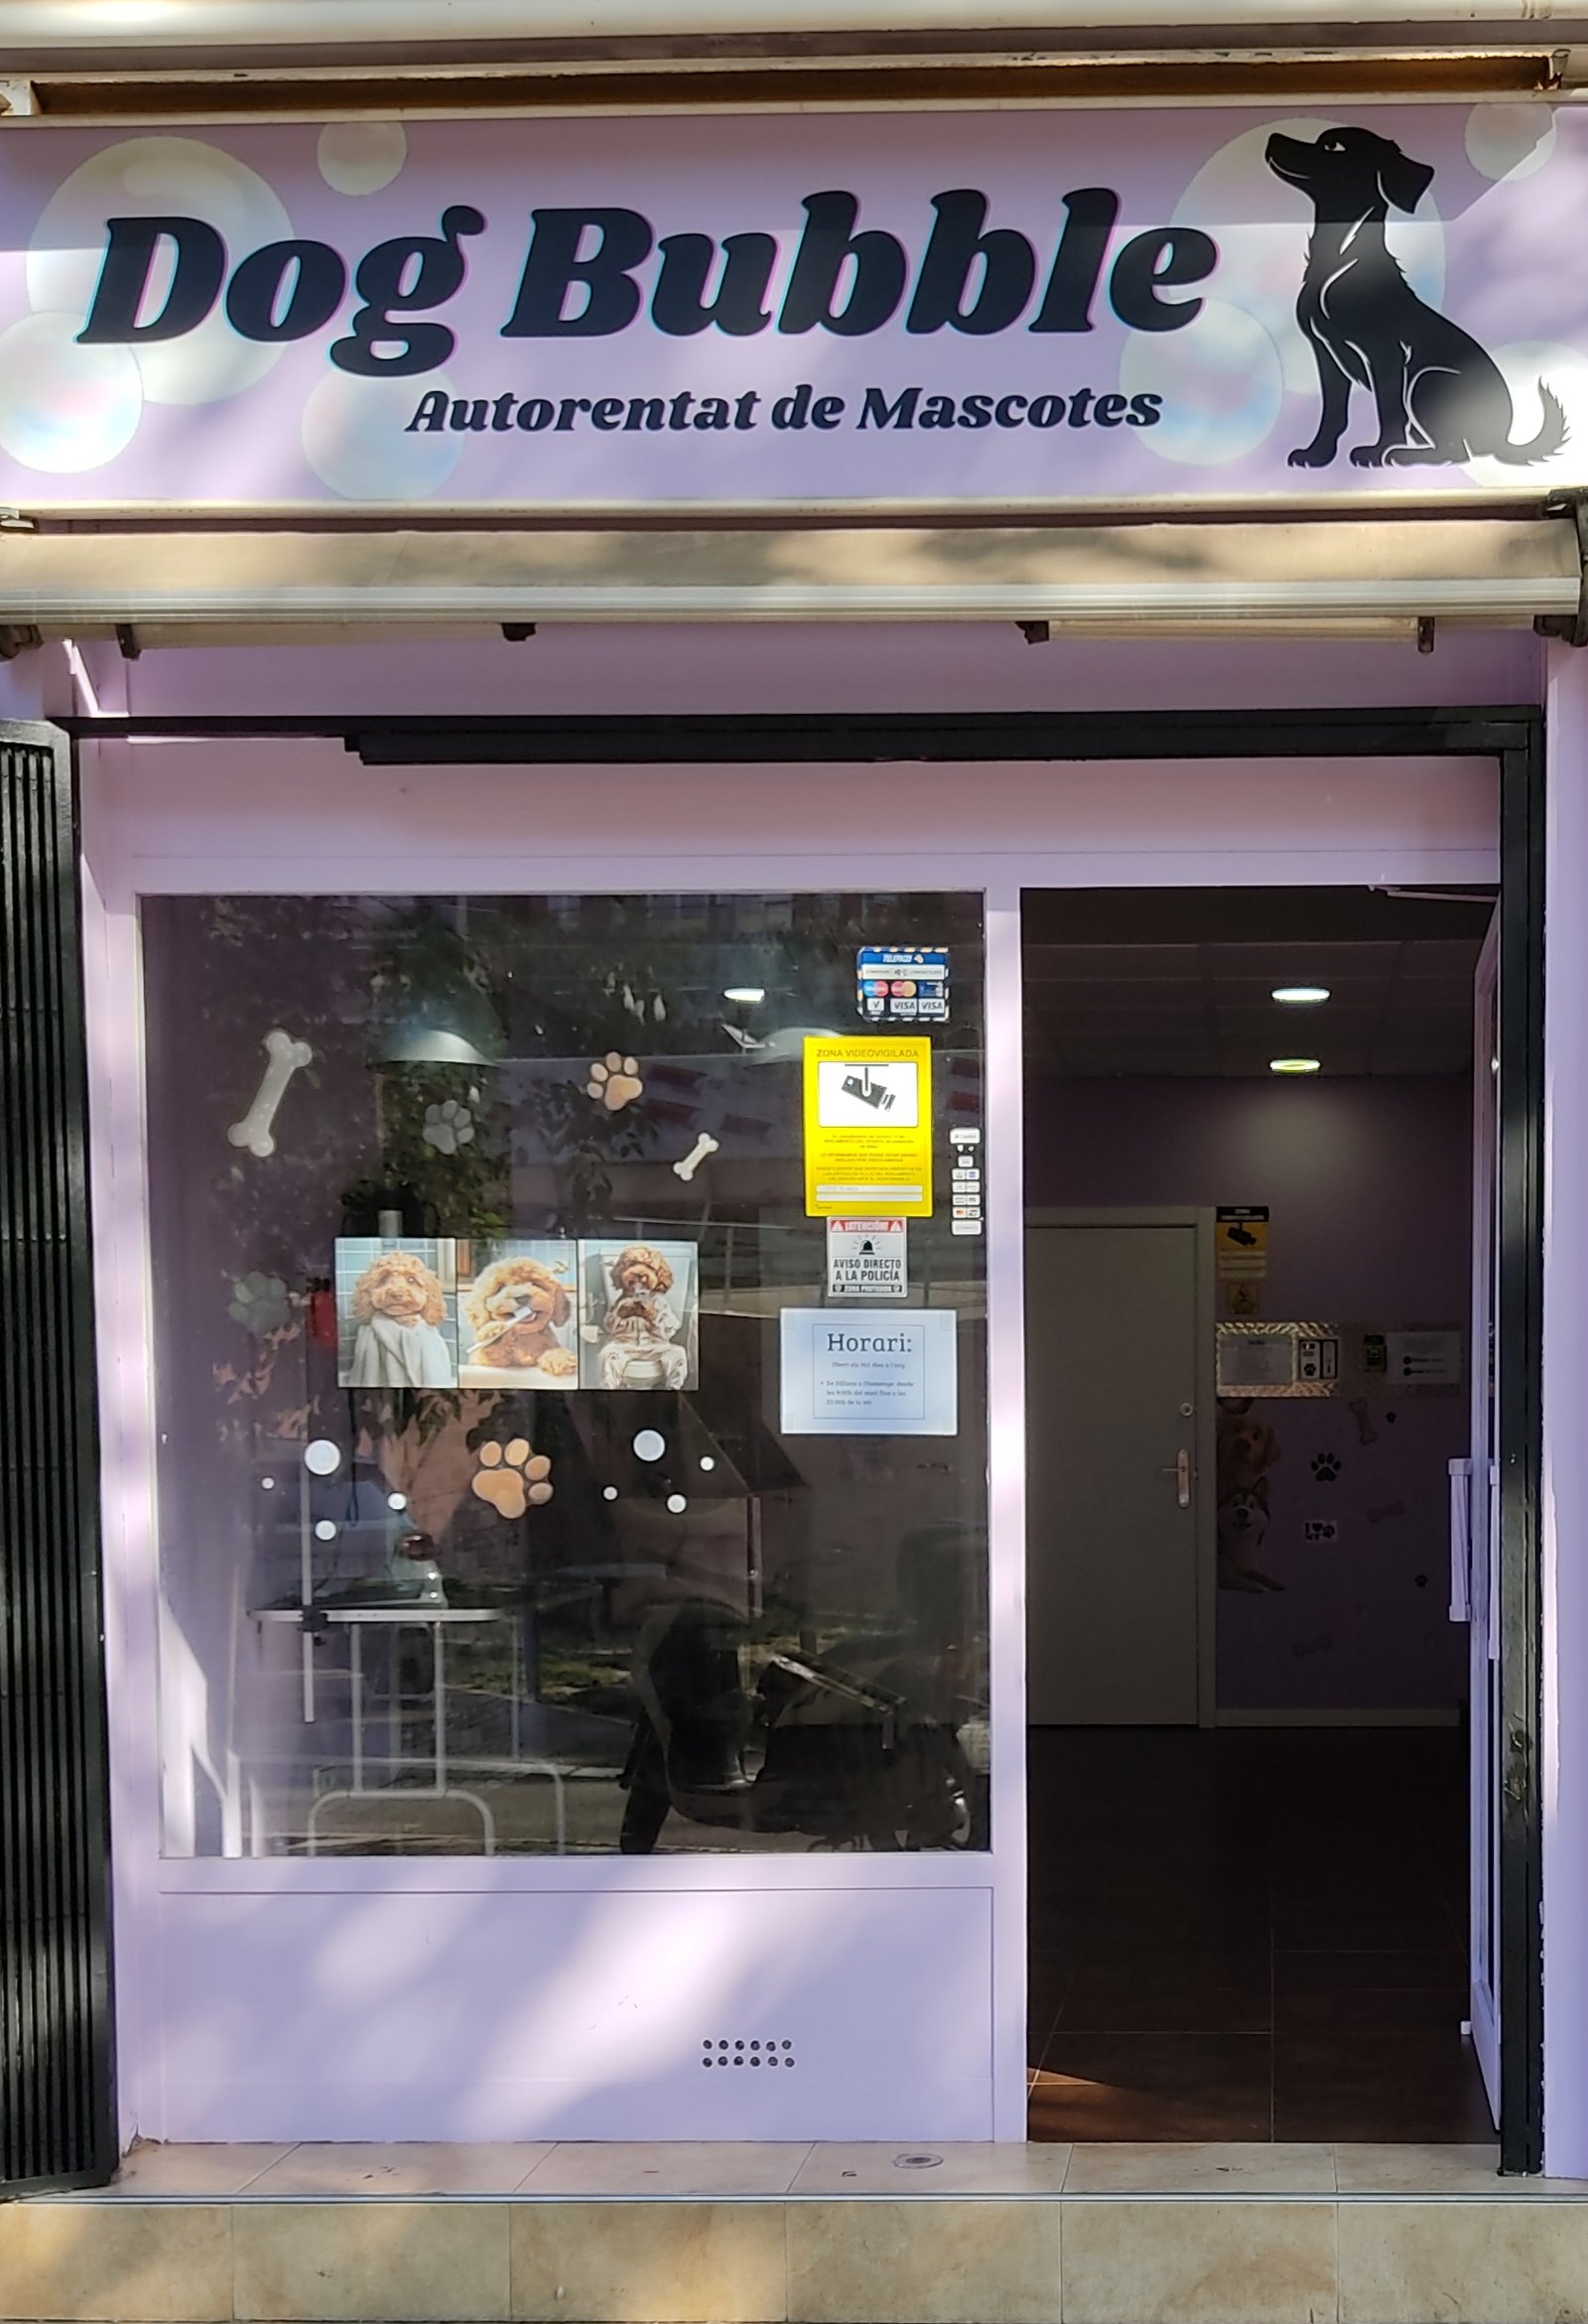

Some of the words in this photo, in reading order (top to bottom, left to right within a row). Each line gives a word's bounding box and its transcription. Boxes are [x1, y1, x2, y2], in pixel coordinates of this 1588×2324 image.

[74, 205, 487, 377] Dog
[501, 188, 1219, 339] Bubble
[404, 390, 761, 433] Autorentat
[771, 385, 845, 431] de
[856, 385, 1164, 430] Mascotes
[834, 1259, 860, 1269] AVISO
[863, 1259, 901, 1269] DIRECTO
[836, 1271, 842, 1281] A
[846, 1271, 858, 1281] LA
[860, 1270, 899, 1281] POLICÍA
[827, 1333, 911, 1352] Horari:
